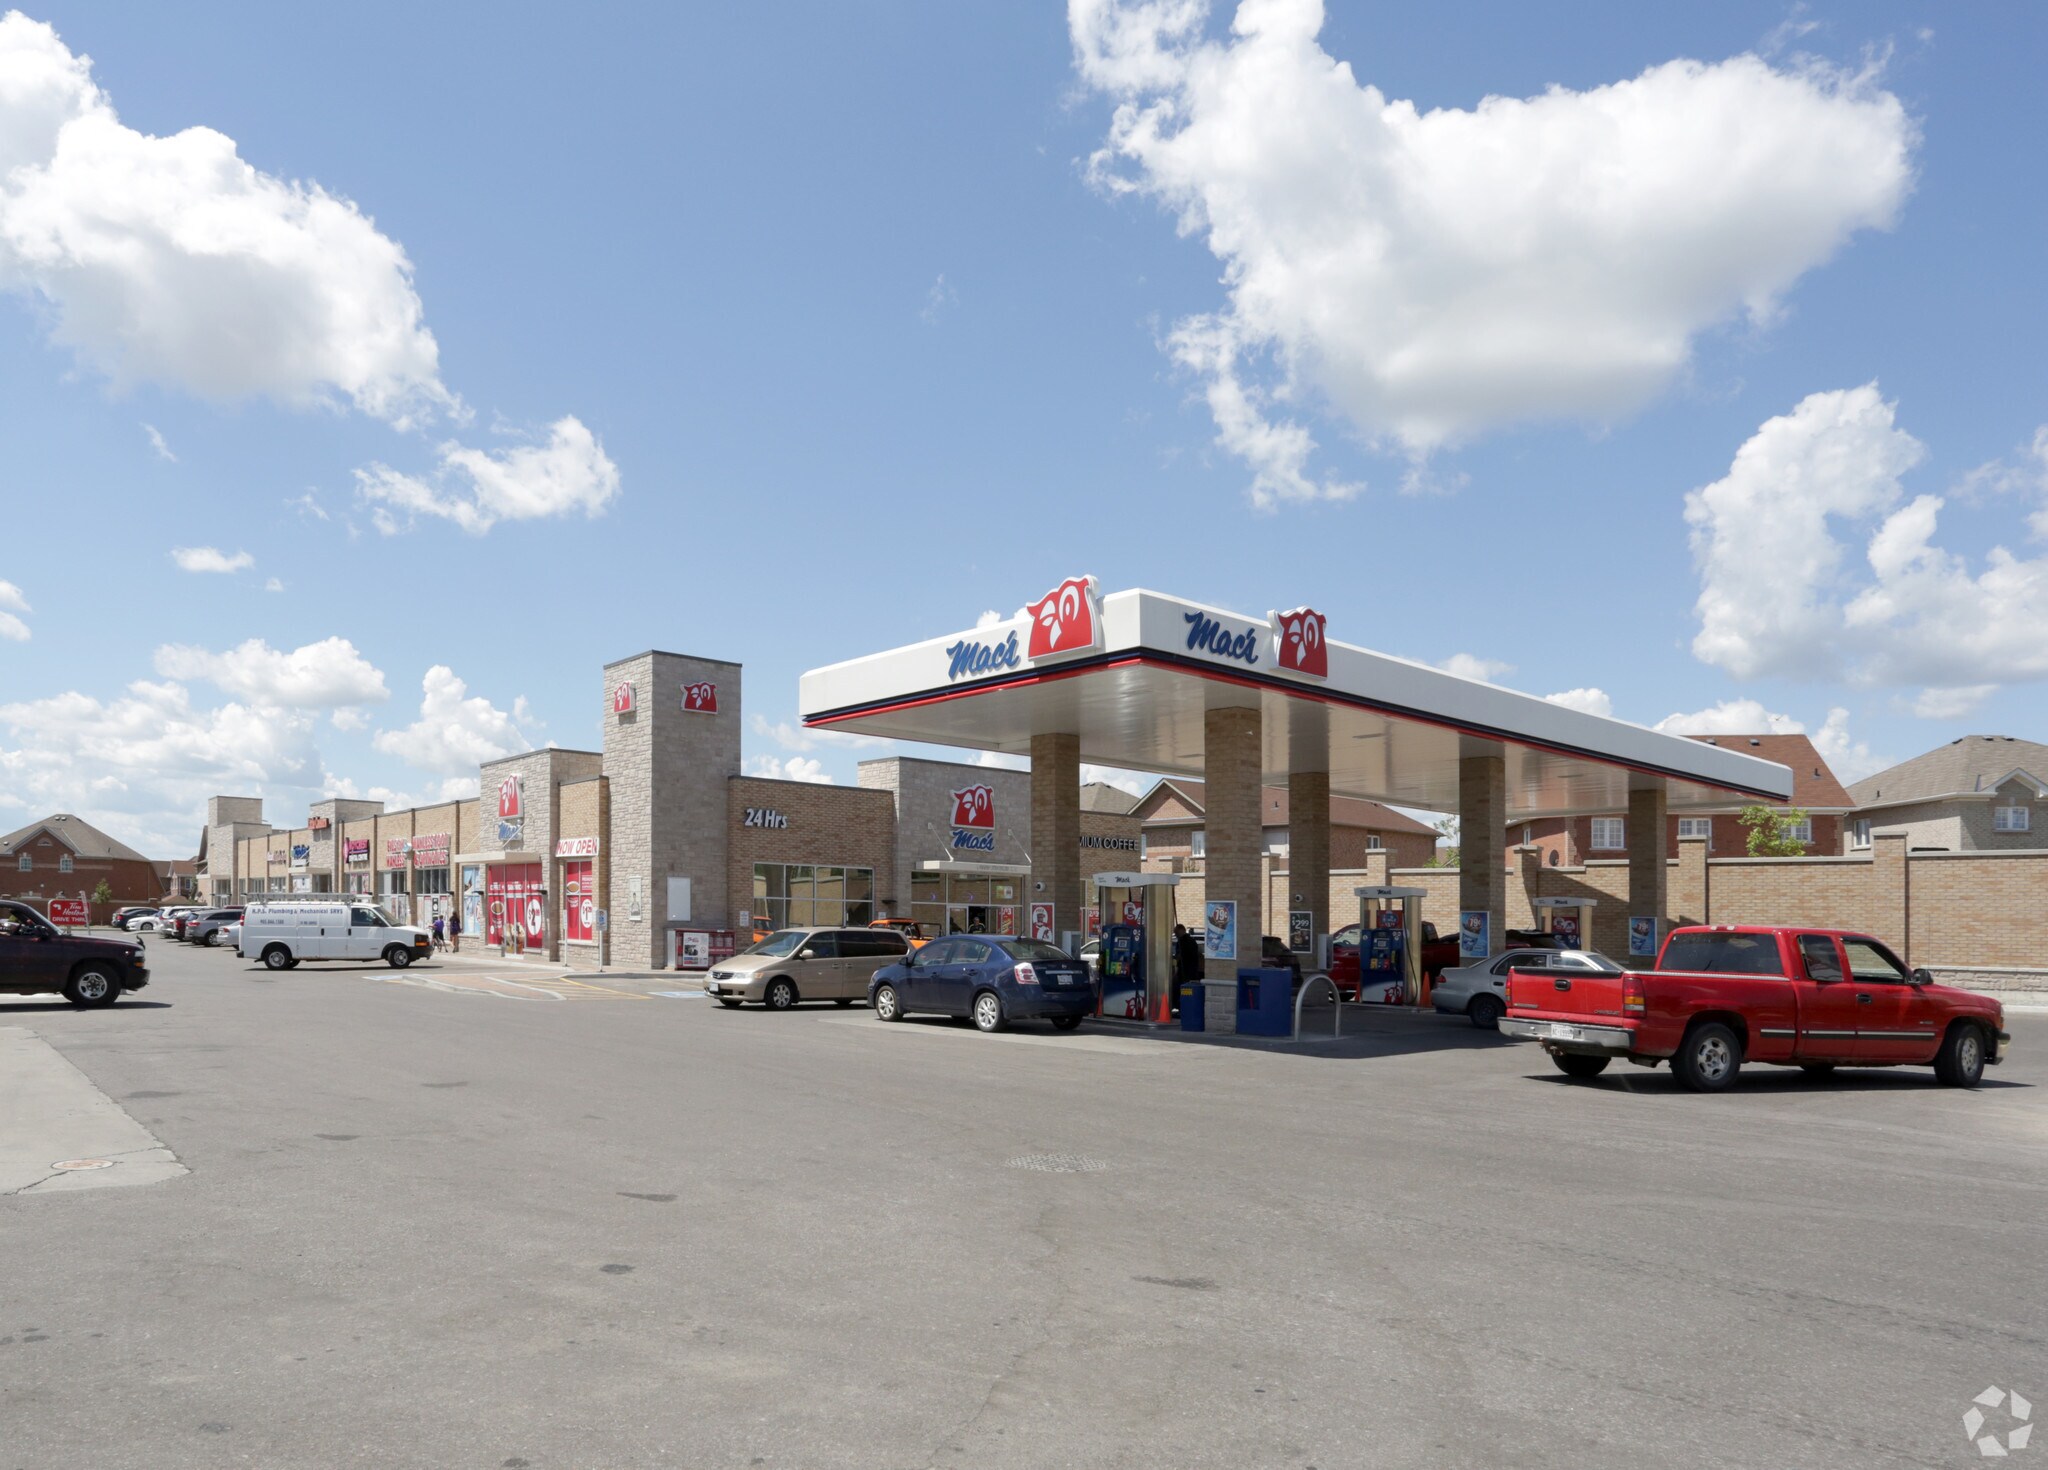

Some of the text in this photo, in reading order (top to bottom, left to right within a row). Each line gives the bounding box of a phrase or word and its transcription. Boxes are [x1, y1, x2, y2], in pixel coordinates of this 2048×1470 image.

[1184, 611, 1259, 665] Mac's
[945, 630, 1021, 681] Mac's
[744, 808, 788, 829] 24 Hrs
[556, 837, 598, 855] NOW OPEN
[950, 829, 995, 852] Mac's
[1102, 837, 1140, 851] COFFEE
[69, 902, 82, 910] Tim
[1215, 909, 1228, 921] 79¢
